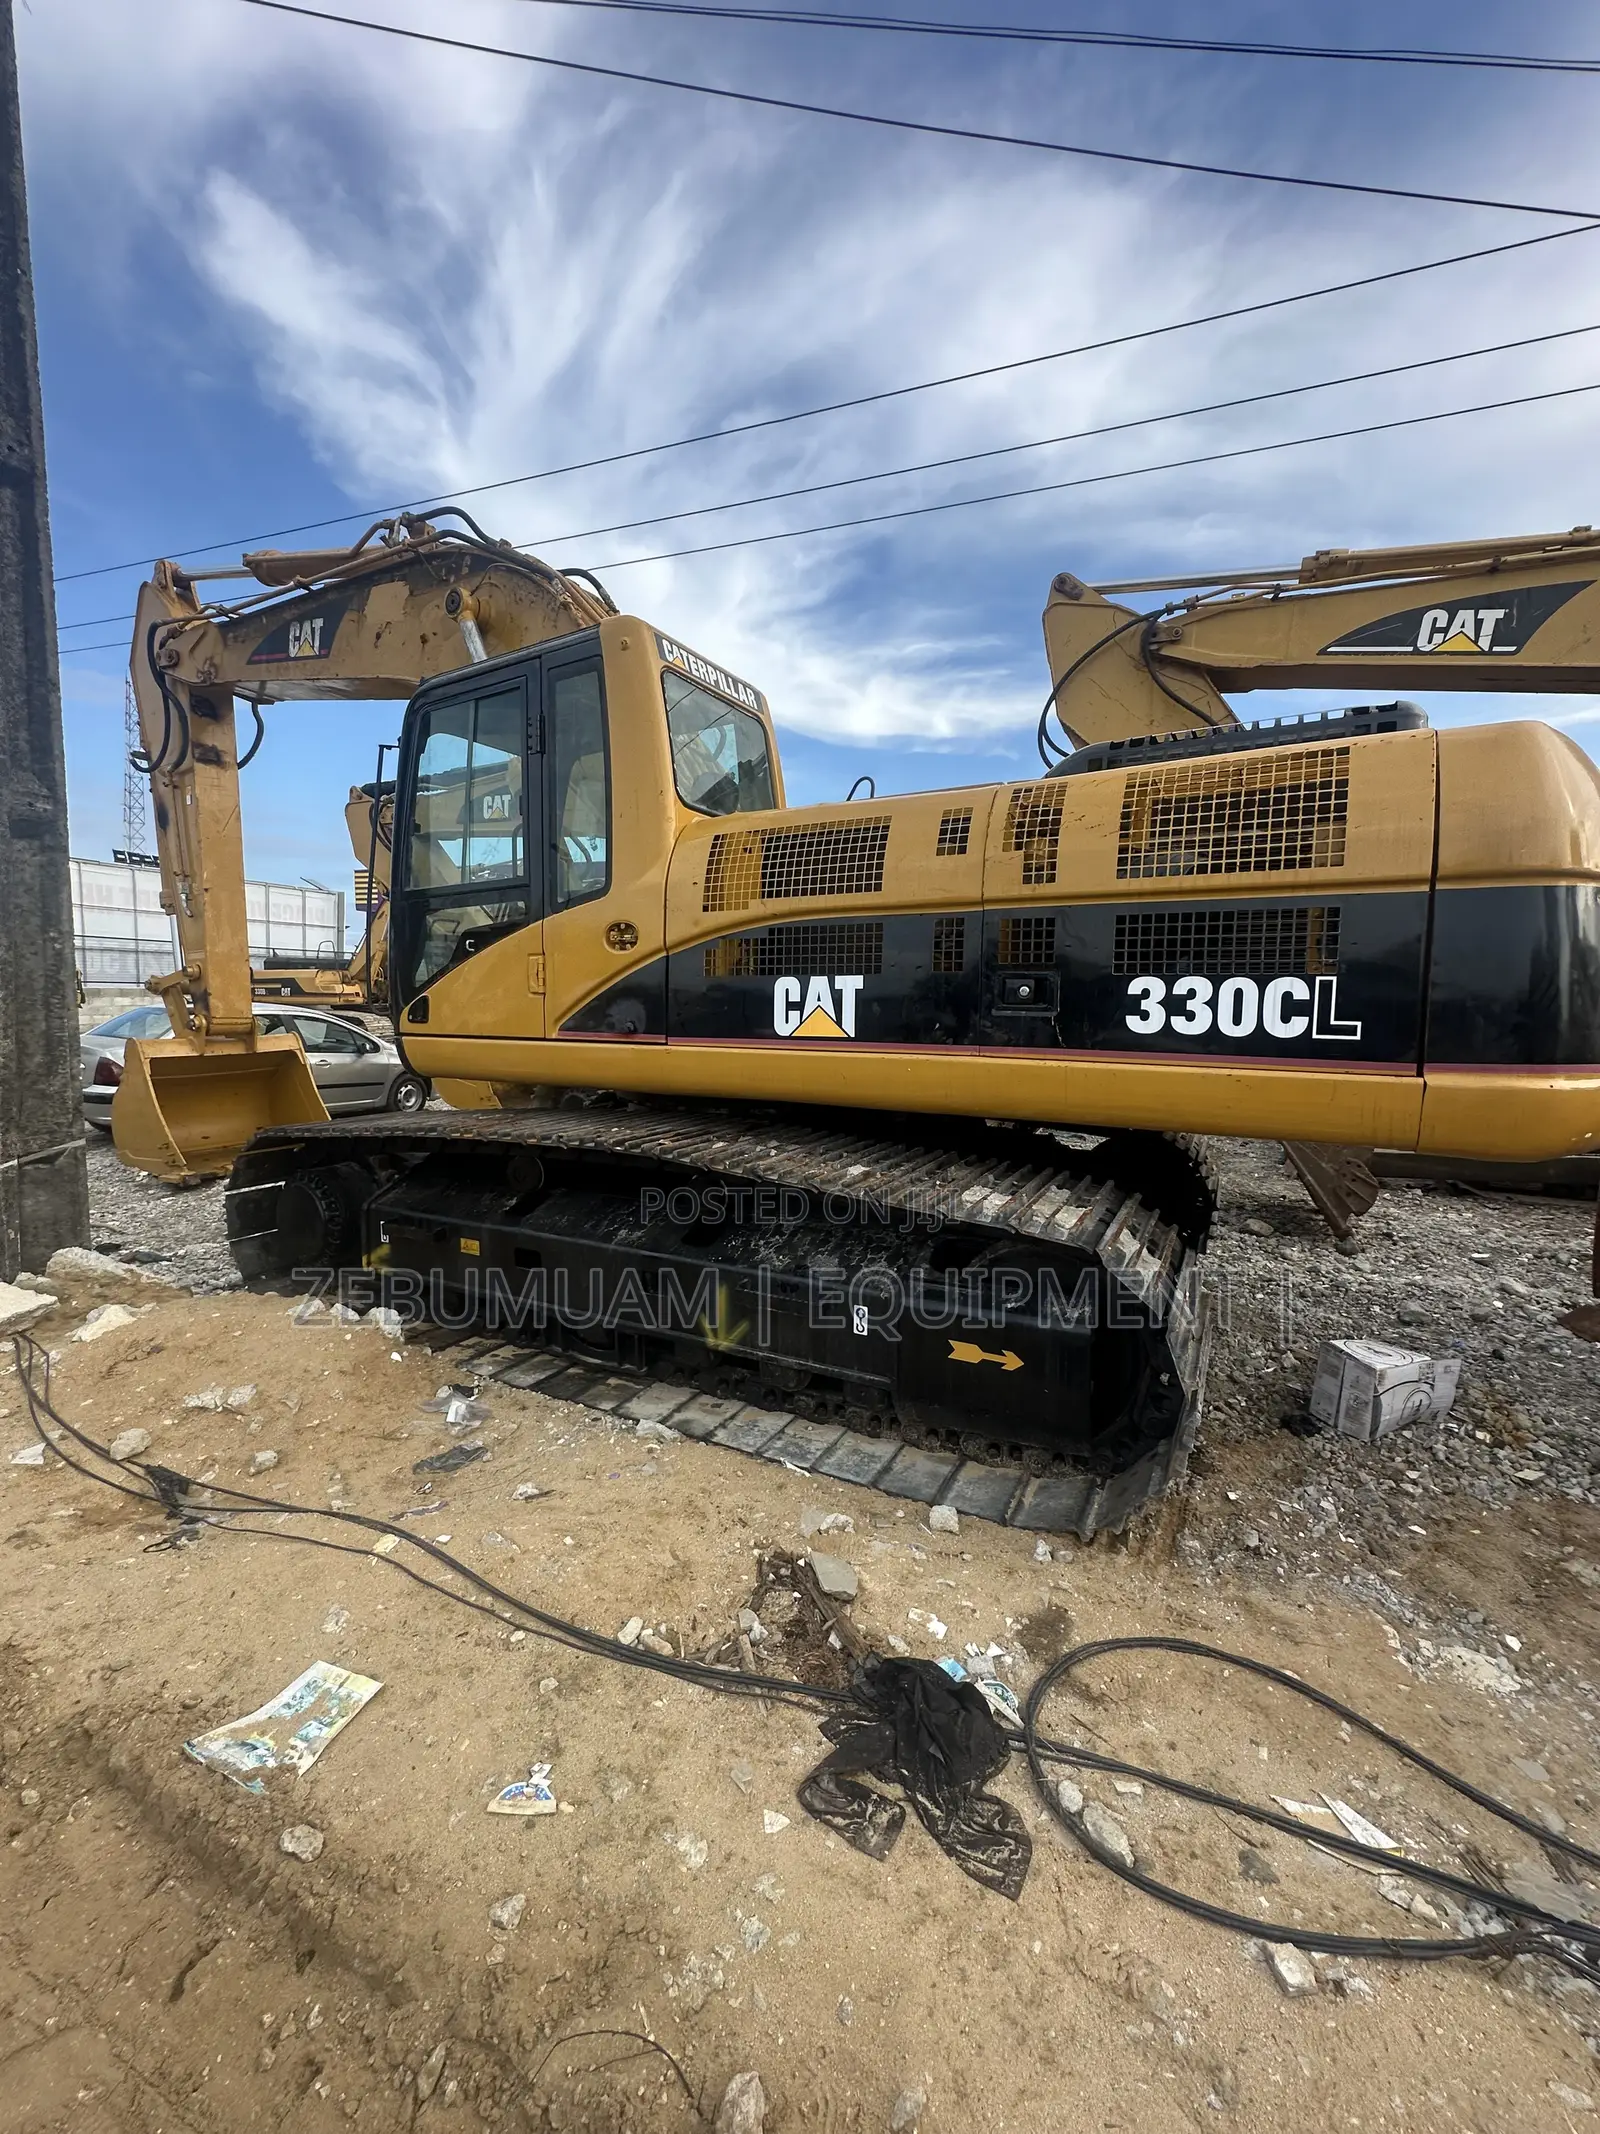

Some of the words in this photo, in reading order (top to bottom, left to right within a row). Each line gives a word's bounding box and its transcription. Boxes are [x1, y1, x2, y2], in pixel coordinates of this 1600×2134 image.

[289, 618, 323, 657] CAT
[1417, 609, 1505, 651] CAT
[662, 638, 758, 710] CATERPILLAR
[483, 794, 512, 820] CAT
[774, 975, 864, 1037] CAT
[1125, 976, 1362, 1040] 330CL
